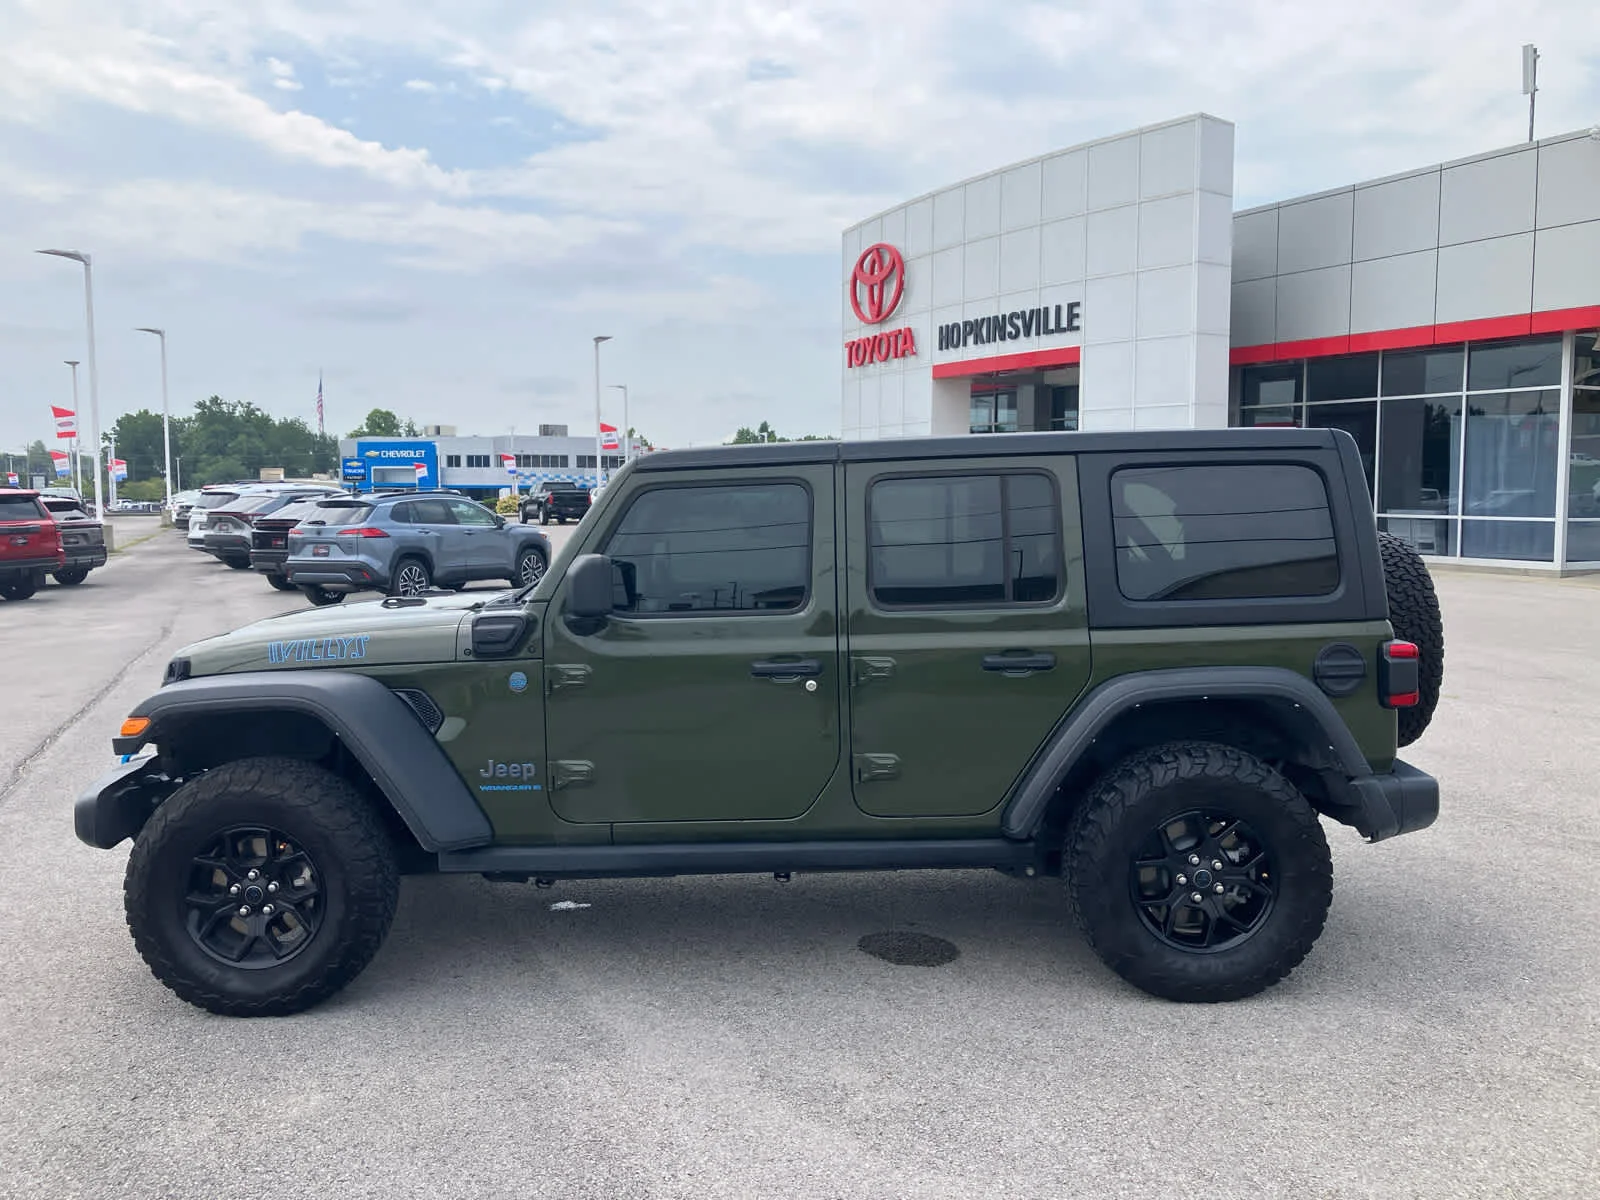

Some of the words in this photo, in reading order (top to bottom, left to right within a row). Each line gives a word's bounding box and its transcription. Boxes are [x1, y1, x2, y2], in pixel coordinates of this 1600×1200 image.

[938, 301, 1081, 351] HOPKINSVILLE
[845, 327, 917, 368] TOYOTA
[381, 450, 425, 458] CHEVROLET
[268, 635, 370, 664] WILLYS
[480, 759, 536, 782] Jeep
